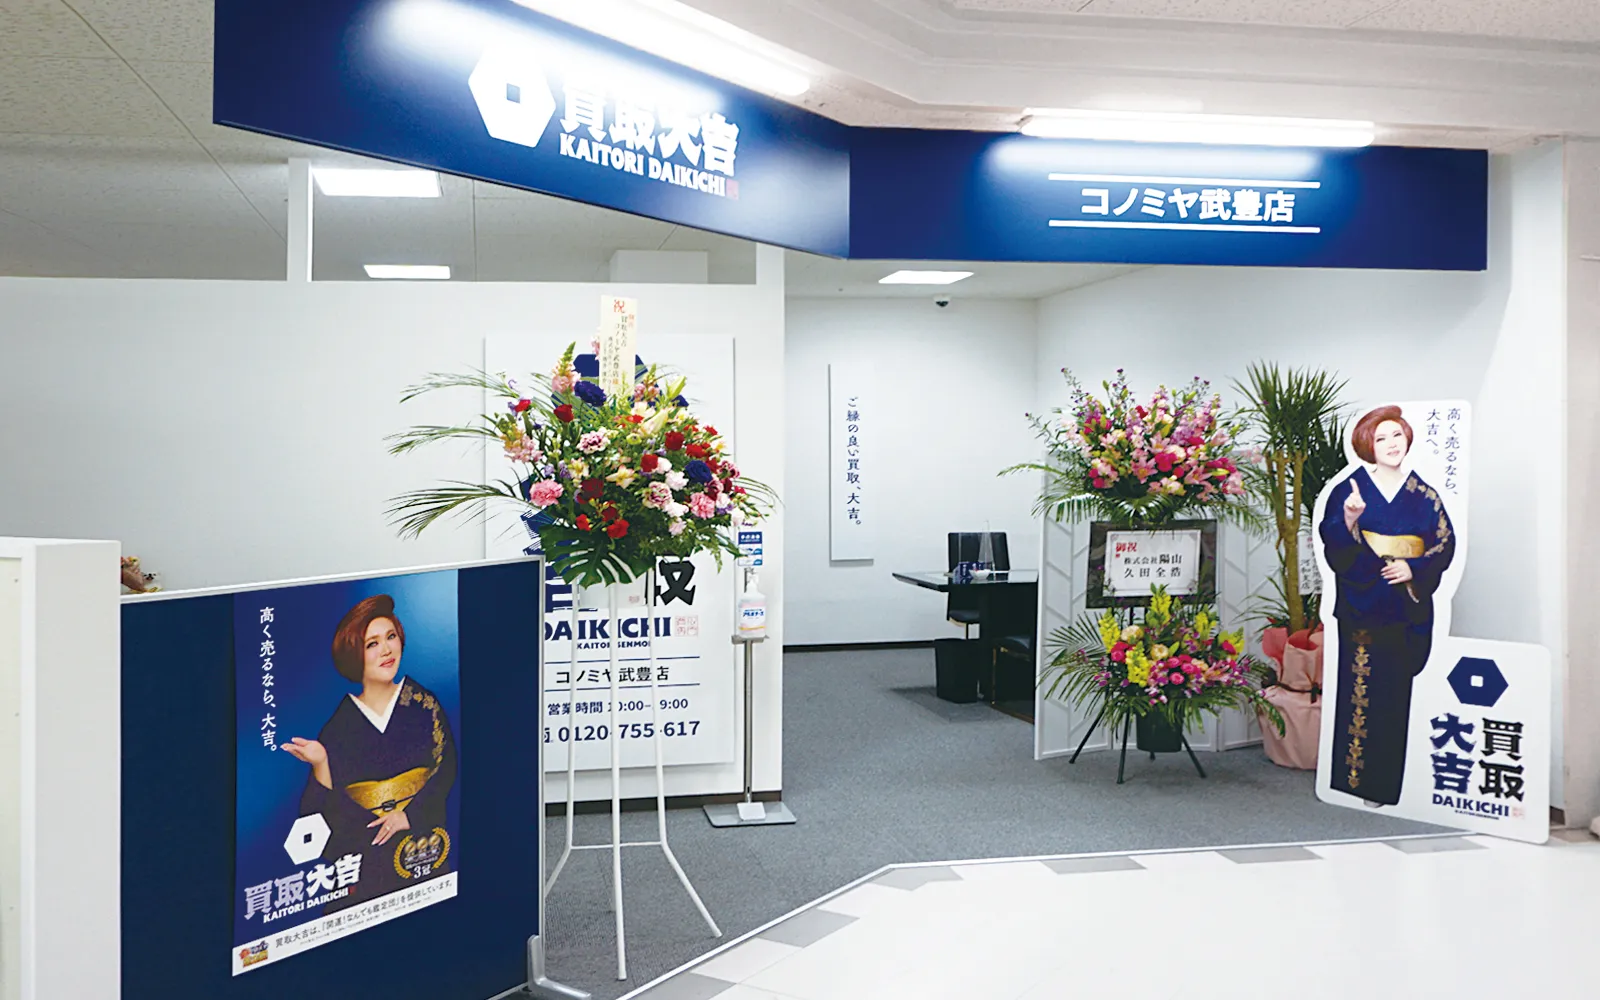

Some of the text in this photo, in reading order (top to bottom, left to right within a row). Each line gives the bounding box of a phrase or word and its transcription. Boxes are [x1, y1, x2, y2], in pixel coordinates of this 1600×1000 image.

[559, 132, 645, 177] KAITORI
[648, 153, 726, 198] DAIKICHI
[1080, 187, 1297, 223] コノミヤ武豊店
[846, 396, 861, 525] ご縁の良い買取、大吉。
[1426, 408, 1441, 455] 大吉へ。
[1445, 407, 1461, 495] 高く売るなら、
[1115, 542, 1137, 553] 御祝
[259, 606, 277, 752] 高く売るなら、大吉。
[548, 701, 603, 716] 営業時間
[1429, 712, 1477, 795] 大吉
[1478, 717, 1525, 802] 買取
[1432, 793, 1510, 817] DAIKICHI
[243, 853, 363, 921] 買取大吉
[262, 901, 305, 924] KAITORI
[306, 886, 349, 909] DAIKICHI
